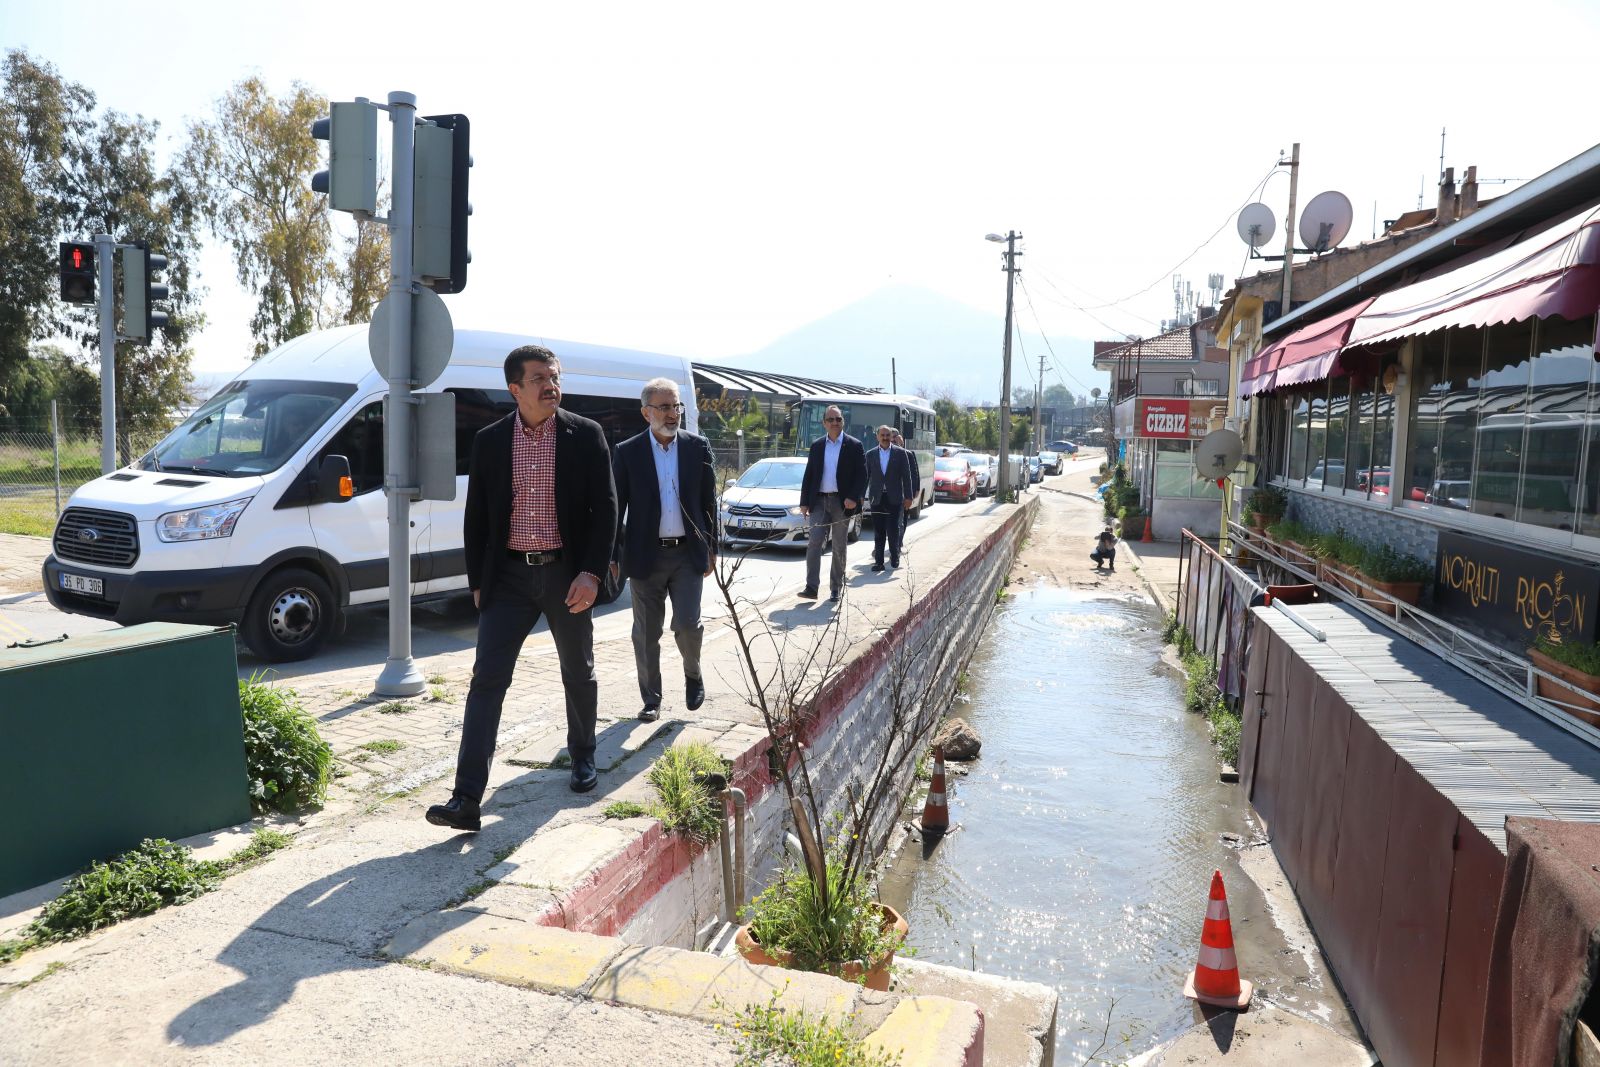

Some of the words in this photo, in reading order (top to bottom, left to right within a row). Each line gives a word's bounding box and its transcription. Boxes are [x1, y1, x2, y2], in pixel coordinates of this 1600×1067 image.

[64, 575, 72, 588] 35
[76, 577, 85, 590] PD
[89, 579, 102, 593] 306
